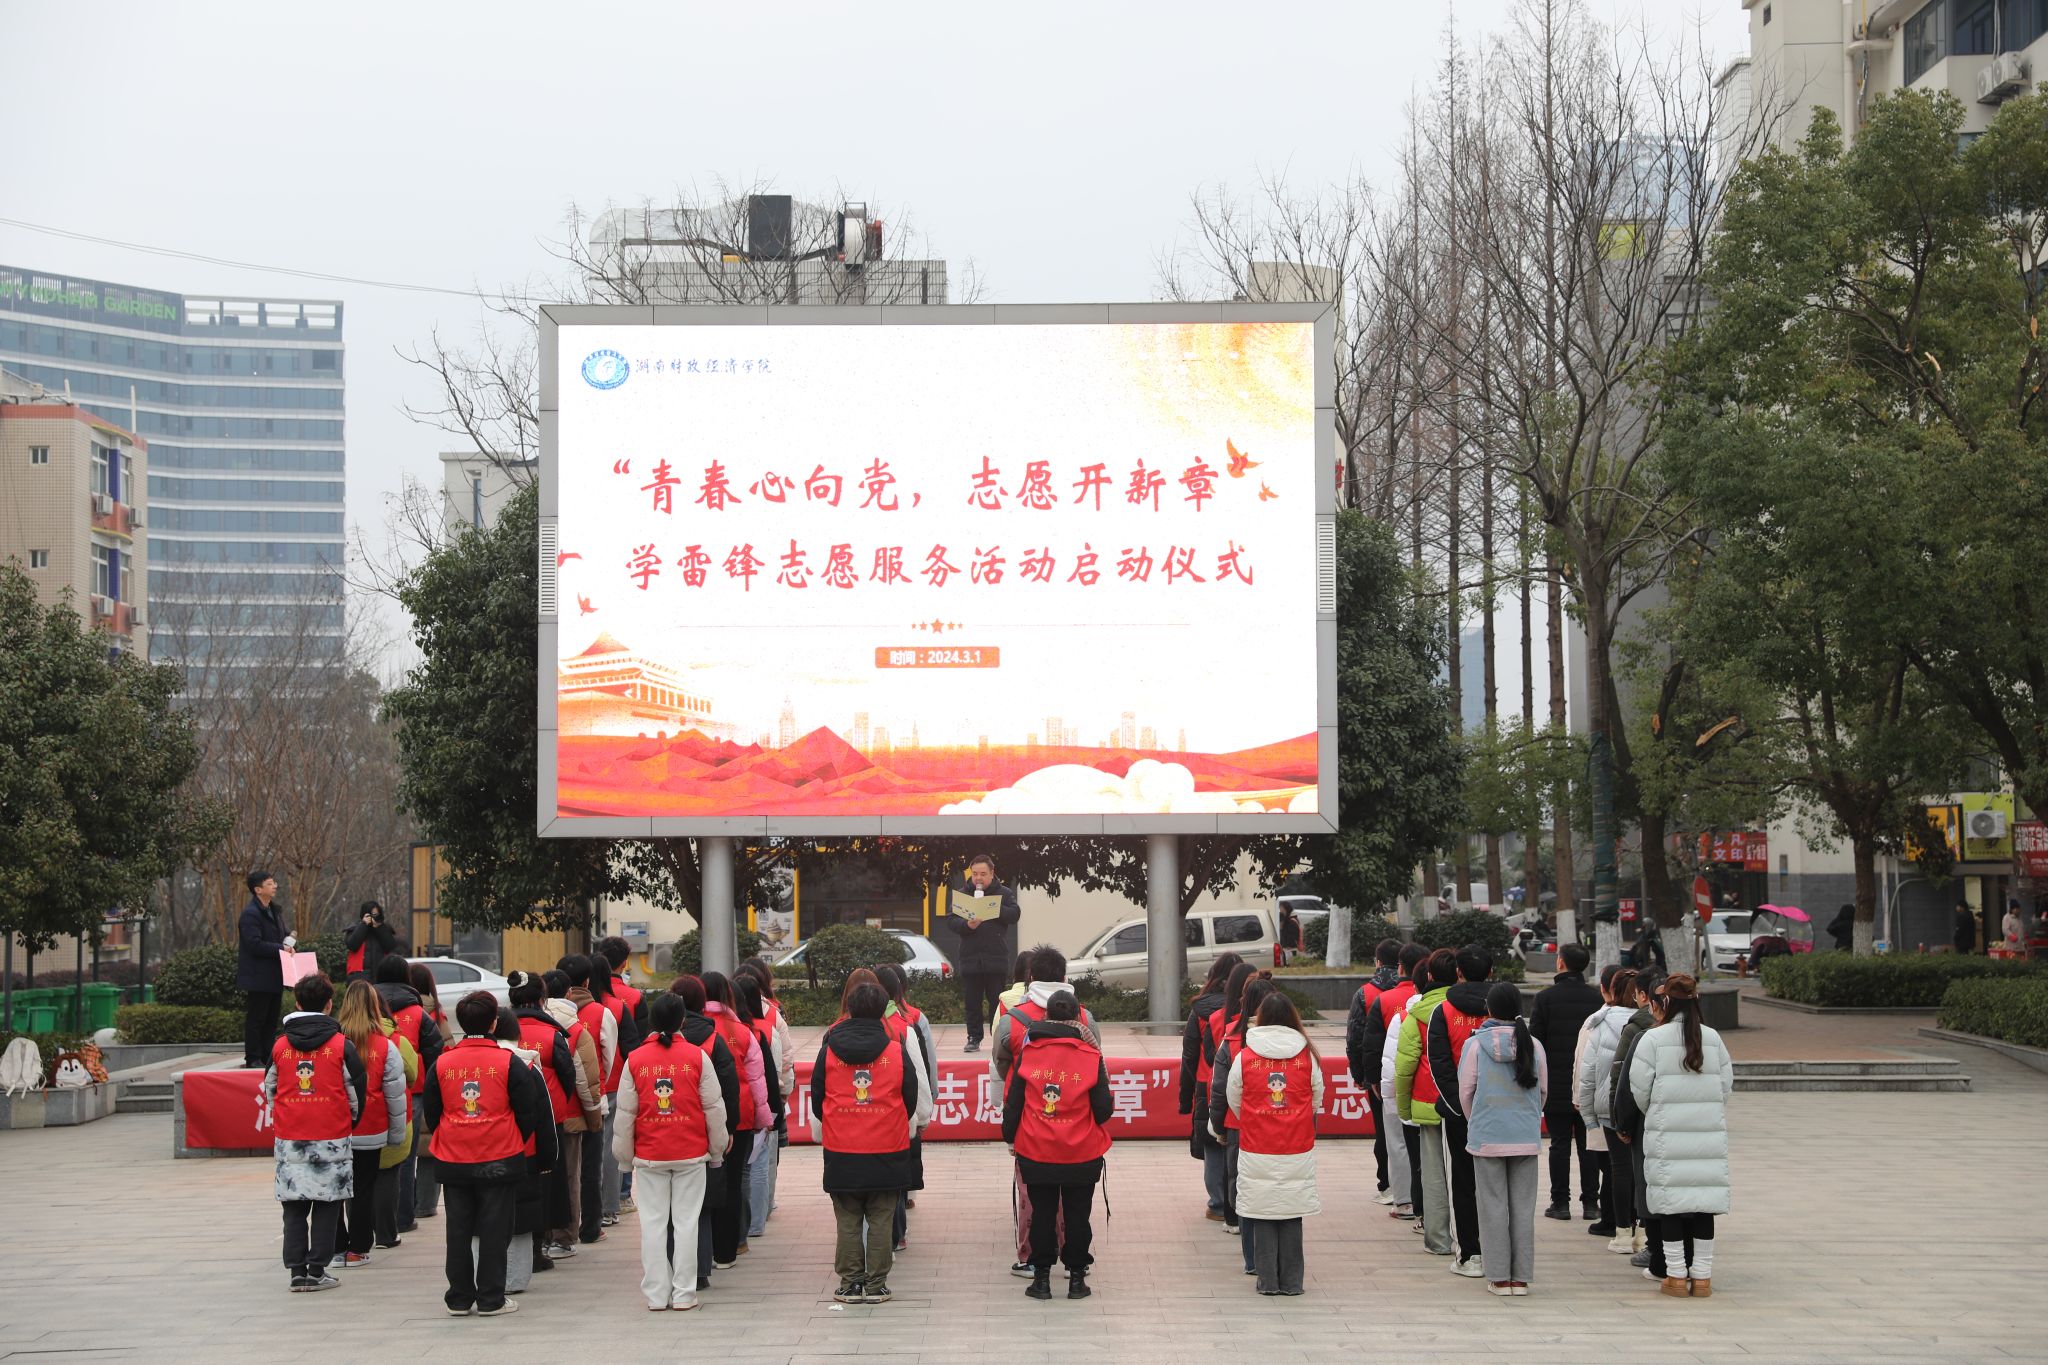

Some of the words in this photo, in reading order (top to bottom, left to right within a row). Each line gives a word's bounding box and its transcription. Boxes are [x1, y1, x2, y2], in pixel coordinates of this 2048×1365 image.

[104, 296, 177, 321] GARDEN
[625, 539, 1254, 592] 学雷锋志愿服务活动启动仪式
[639, 1063, 692, 1077] 湖财青年
[1251, 1058, 1304, 1071] 湖财青年
[445, 1067, 498, 1080] 湖财青年
[1030, 1068, 1082, 1084] 湖财青年
